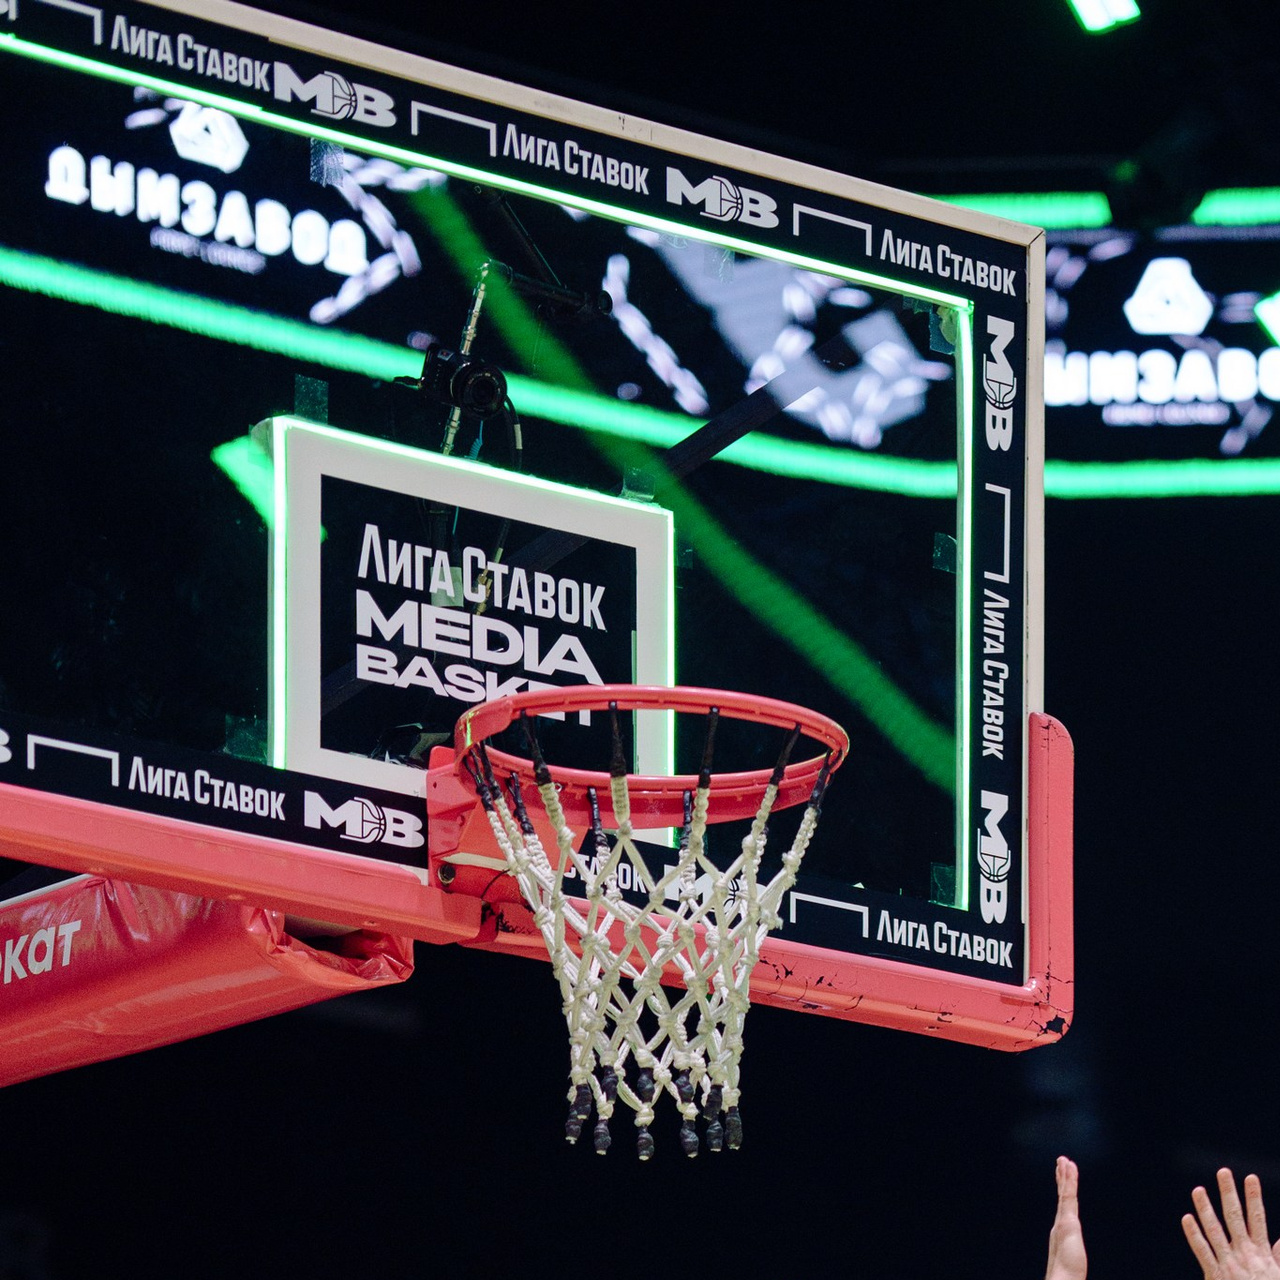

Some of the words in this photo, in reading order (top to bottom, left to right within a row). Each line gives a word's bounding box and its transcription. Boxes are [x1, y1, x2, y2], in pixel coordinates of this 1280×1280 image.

[357, 523, 456, 602] ЛИГА
[462, 546, 608, 631] СТАВОК
[356, 588, 606, 687] MEDIA
[0, 919, 82, 985] кат
